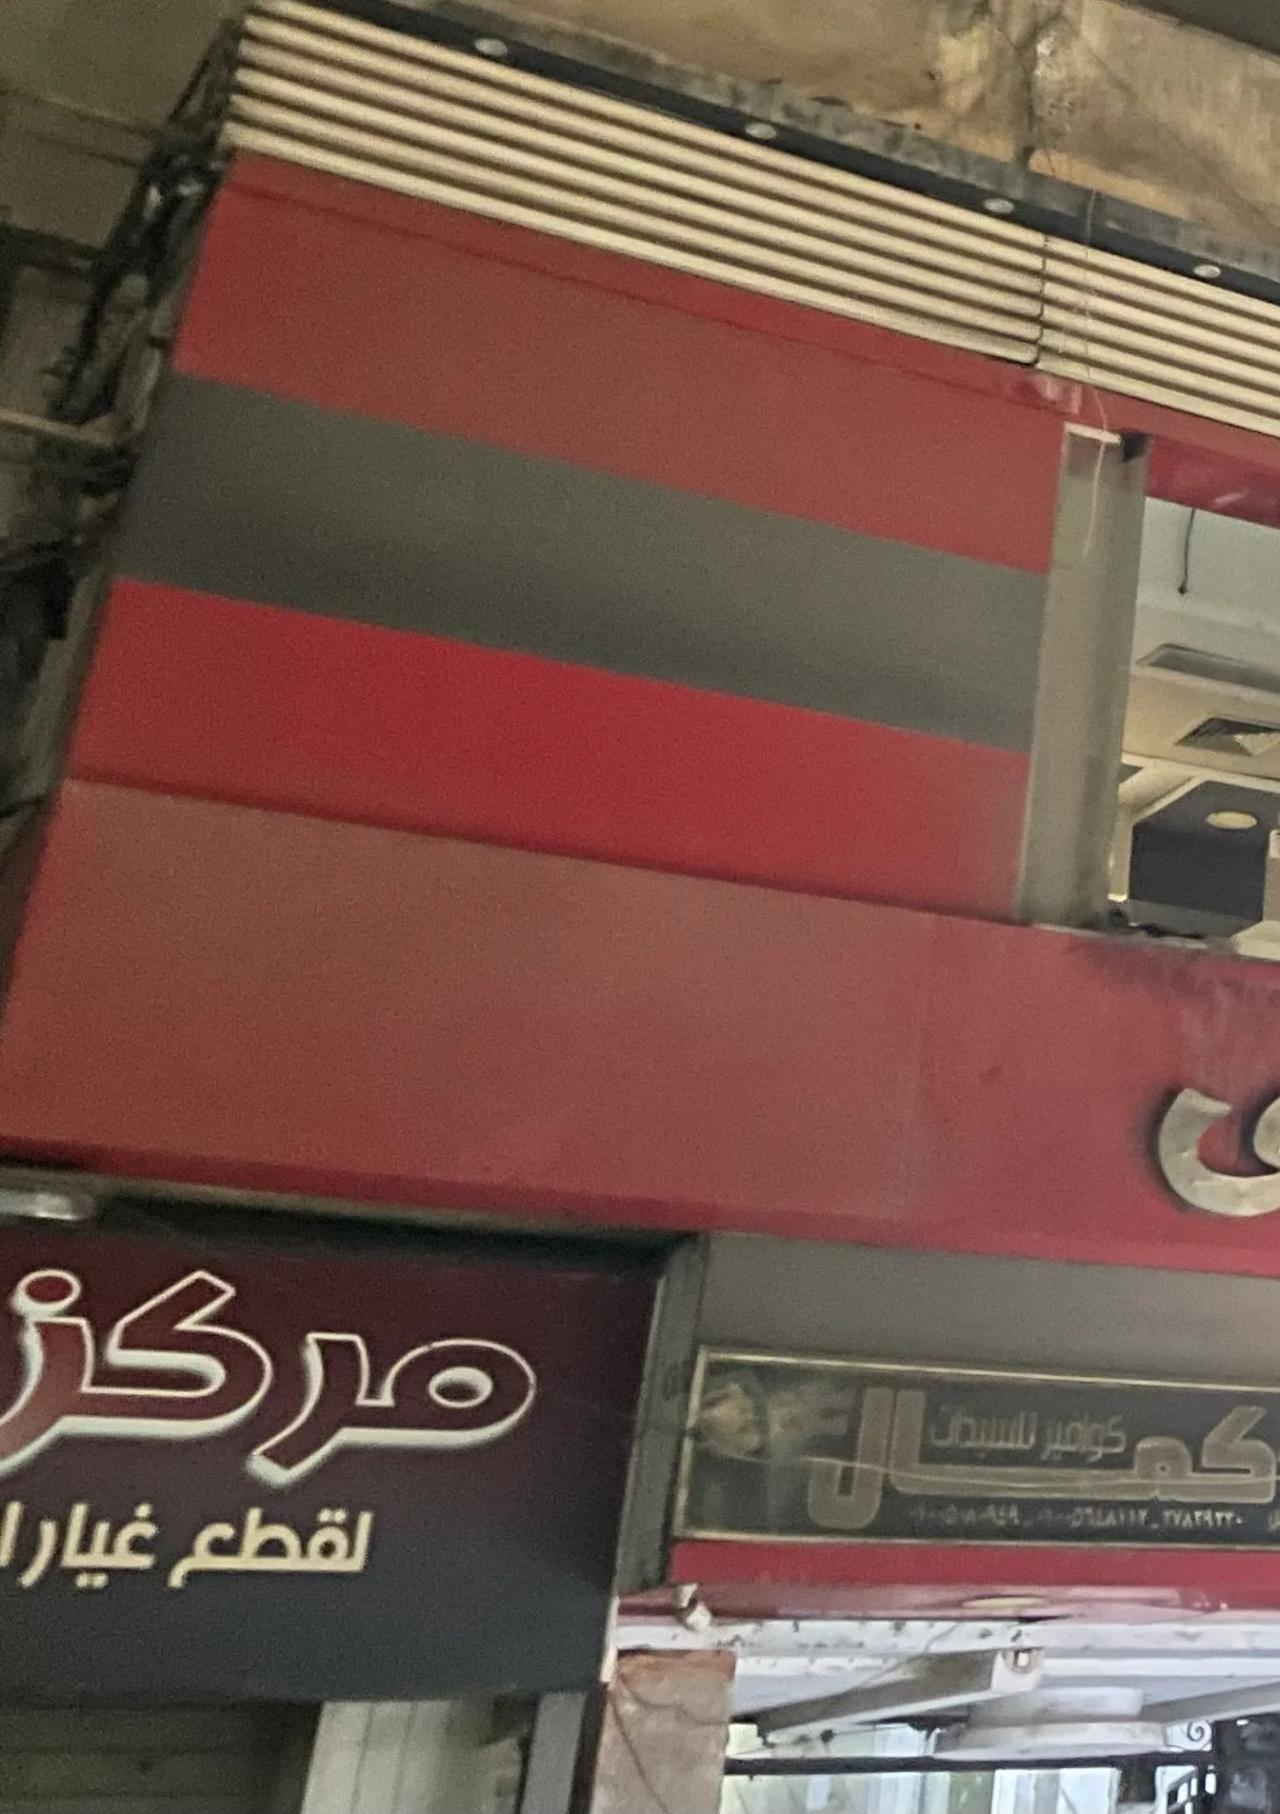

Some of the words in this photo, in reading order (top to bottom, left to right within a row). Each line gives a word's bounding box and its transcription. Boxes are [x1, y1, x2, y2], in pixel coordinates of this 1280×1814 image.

[0, 1268, 537, 1490] مركز
[18, 1501, 159, 1589] غيار
[167, 1507, 375, 1589] لقطع
